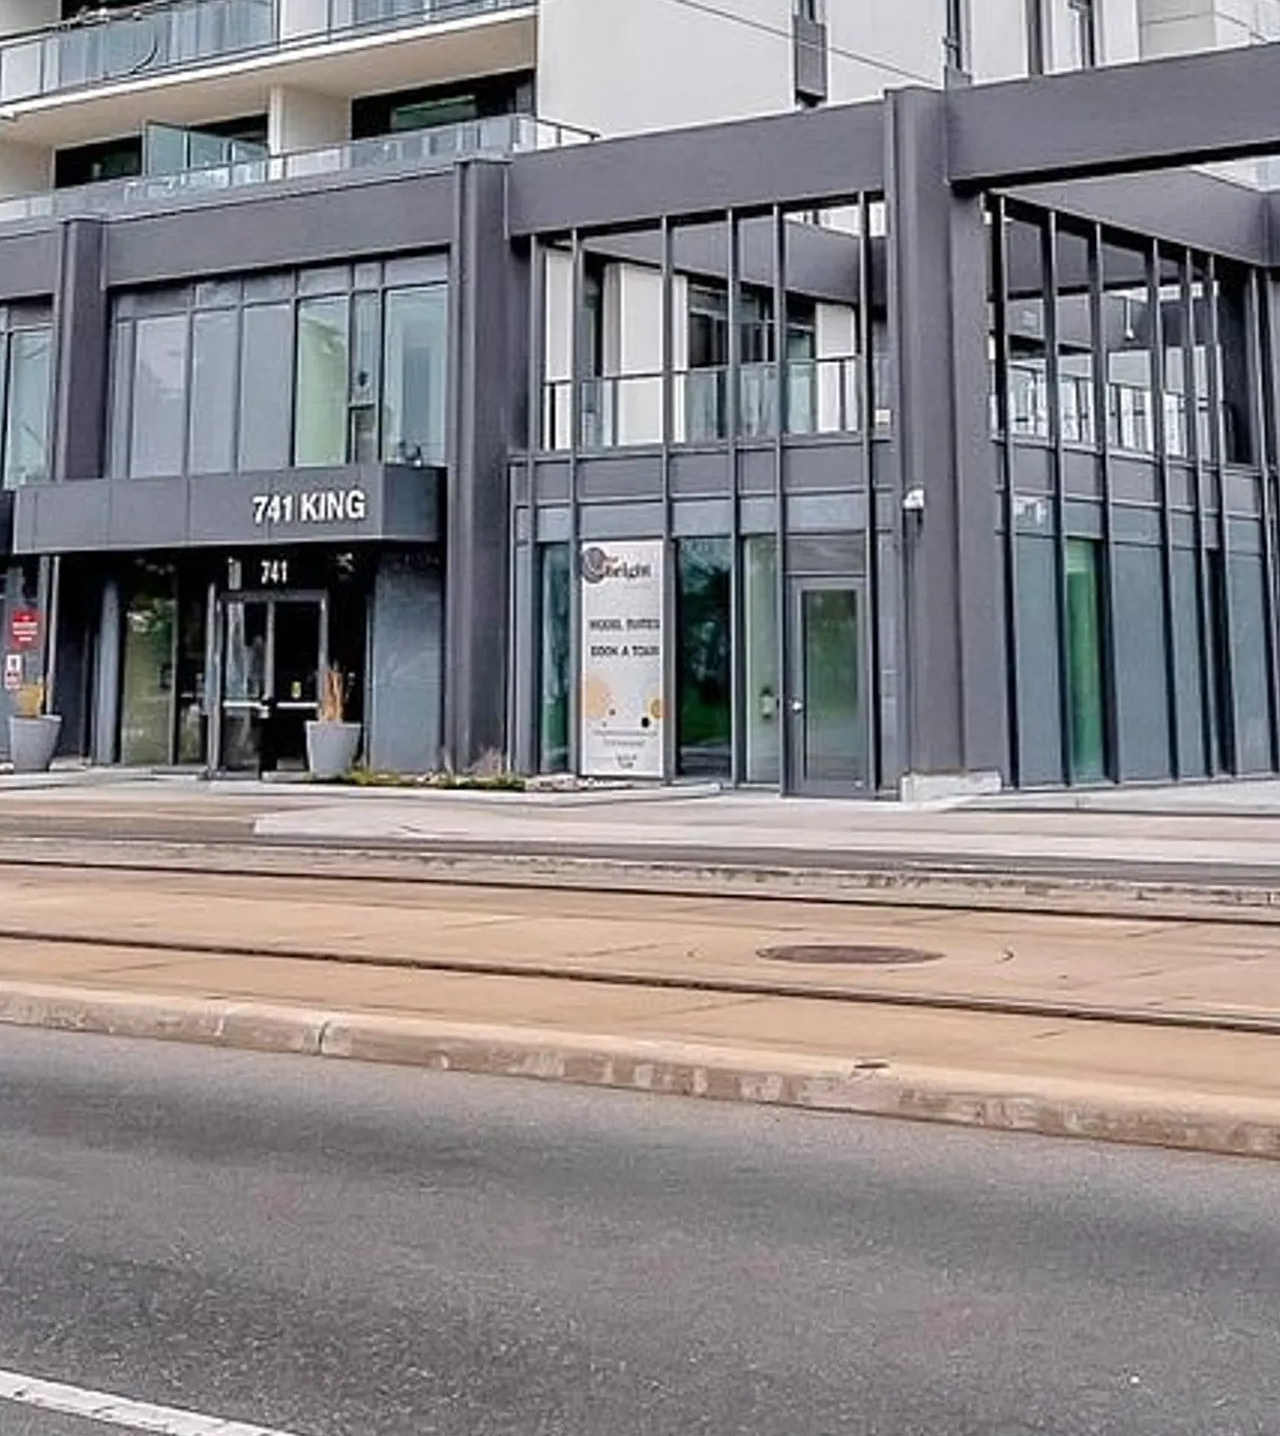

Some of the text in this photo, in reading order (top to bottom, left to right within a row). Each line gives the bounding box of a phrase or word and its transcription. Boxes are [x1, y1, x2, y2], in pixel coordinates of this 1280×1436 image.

[252, 489, 366, 524] 741 KING
[260, 559, 288, 584] 741
[590, 645, 618, 657] BOOK
[621, 645, 629, 657] A
